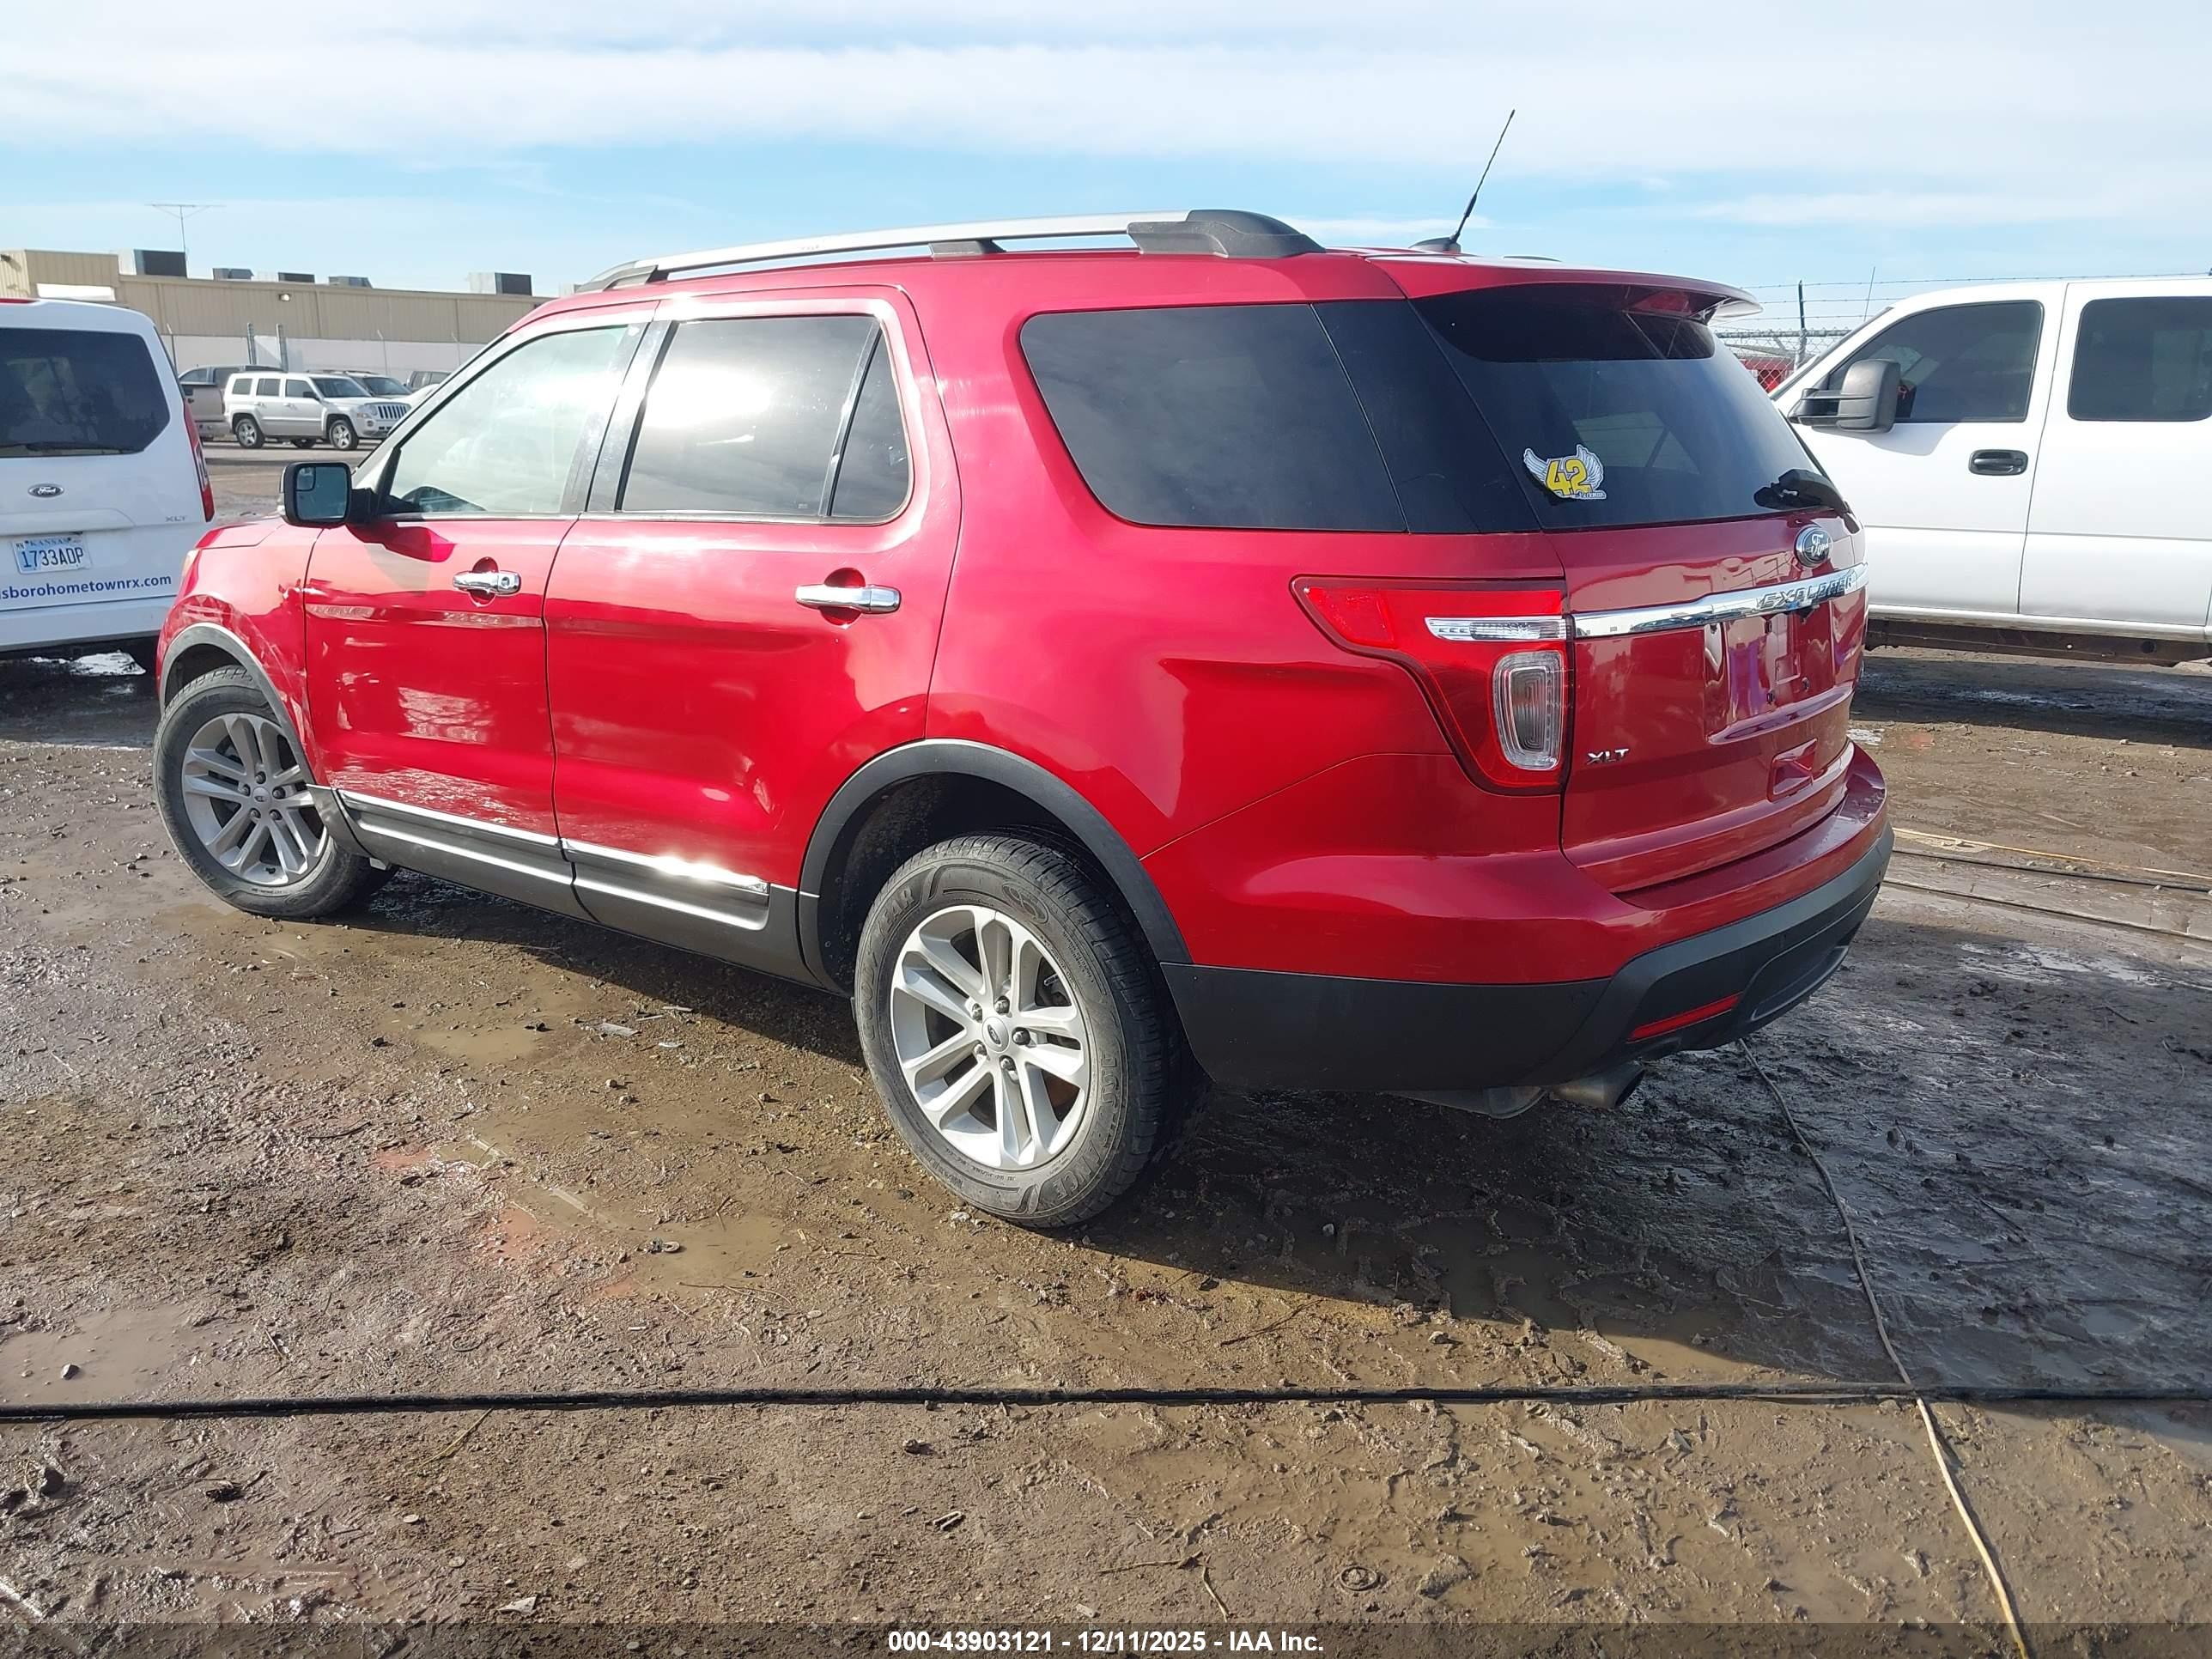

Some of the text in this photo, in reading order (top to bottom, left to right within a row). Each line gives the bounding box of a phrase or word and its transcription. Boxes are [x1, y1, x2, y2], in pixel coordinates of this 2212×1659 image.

[1547, 459, 1593, 495] 42
[21, 547, 84, 568] 1733ADP
[0, 575, 173, 599] sborohometownrx.com
[1587, 748, 1629, 765] XLT
